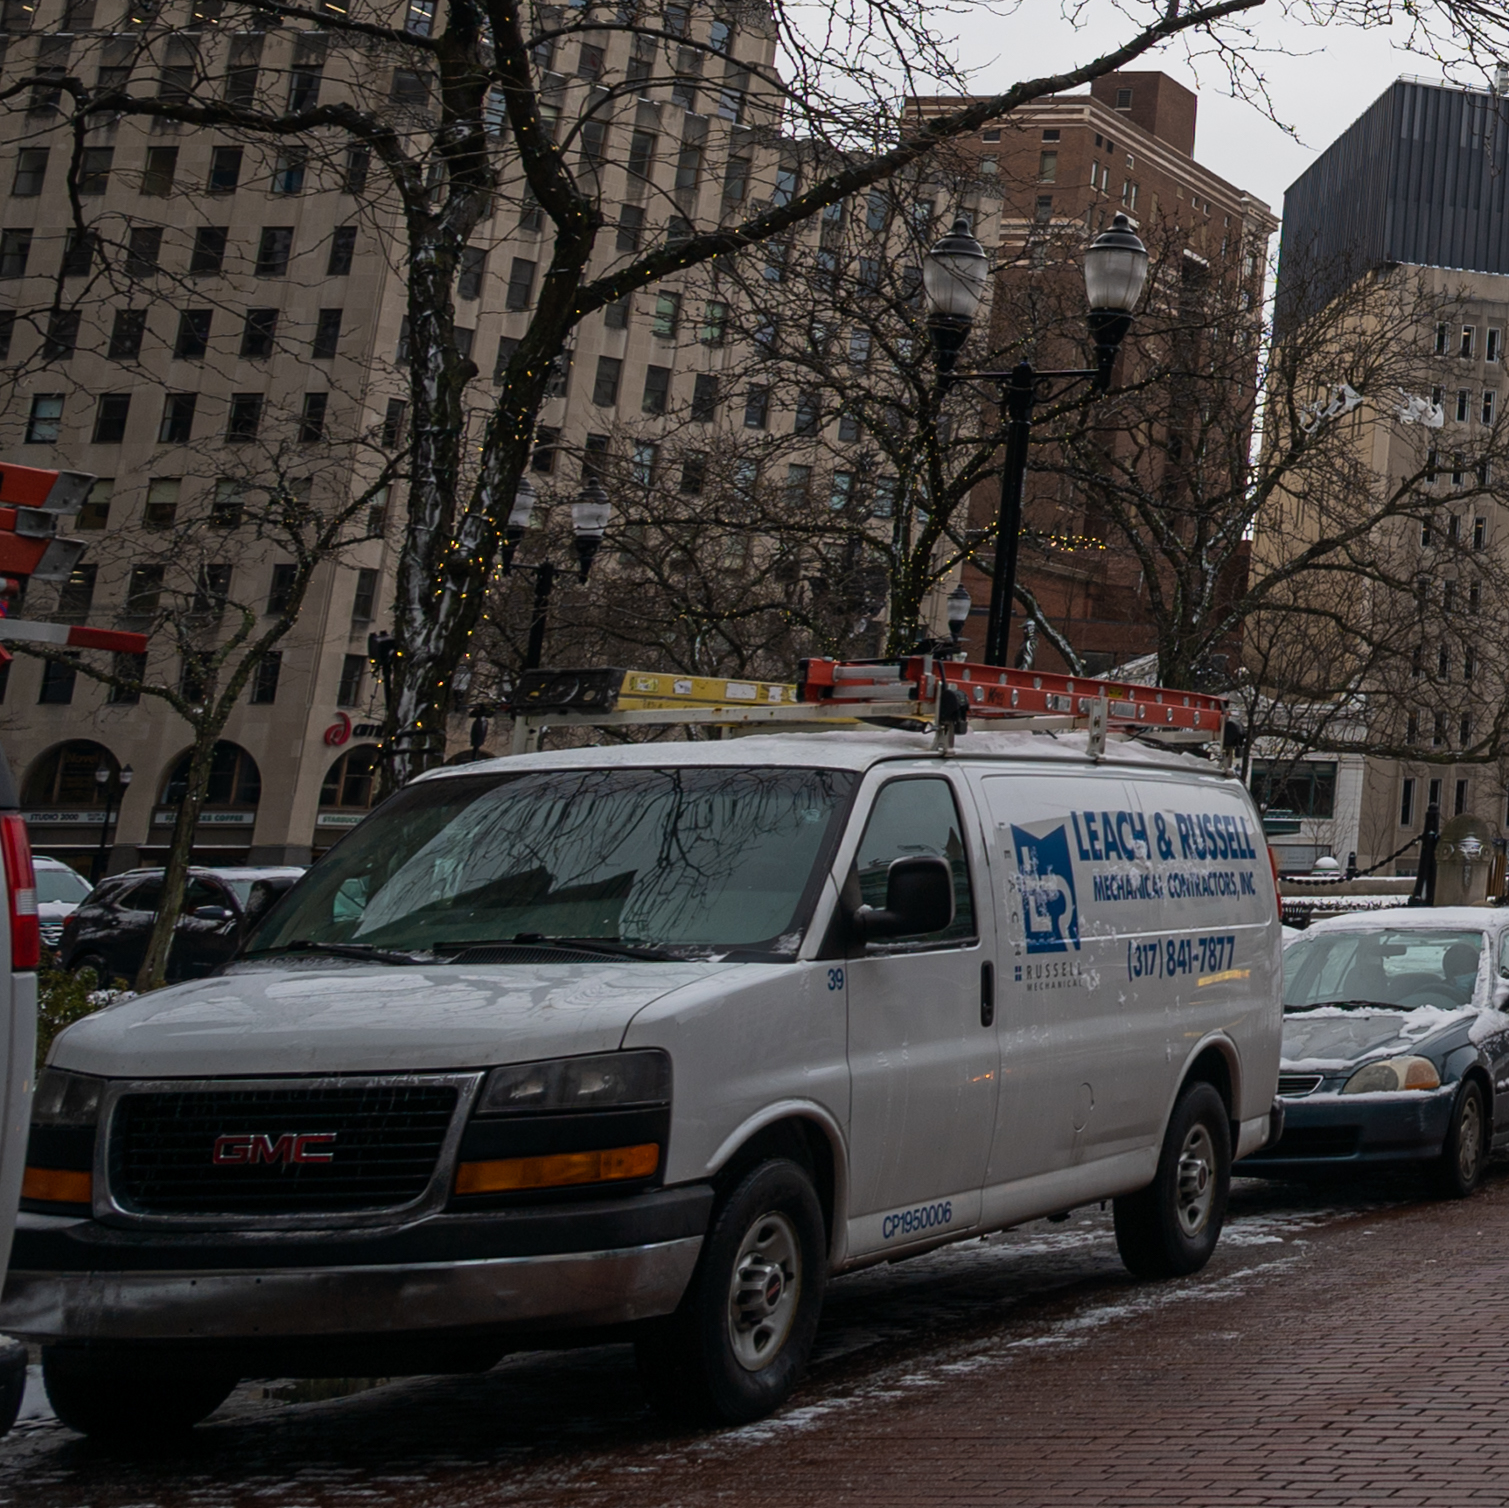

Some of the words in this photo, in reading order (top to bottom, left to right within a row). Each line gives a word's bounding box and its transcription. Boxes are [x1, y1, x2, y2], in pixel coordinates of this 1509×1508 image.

[1070, 811, 1152, 861] LEACH
[1153, 812, 1176, 861] &
[1174, 812, 1256, 861] RUSSELL
[1026, 962, 1083, 980] RUSSELL
[1127, 938, 1164, 982] (317)
[1166, 935, 1235, 977] 841-7877
[828, 968, 844, 991] 39
[213, 1132, 338, 1165] GMC
[883, 1200, 952, 1240] CP1950006
